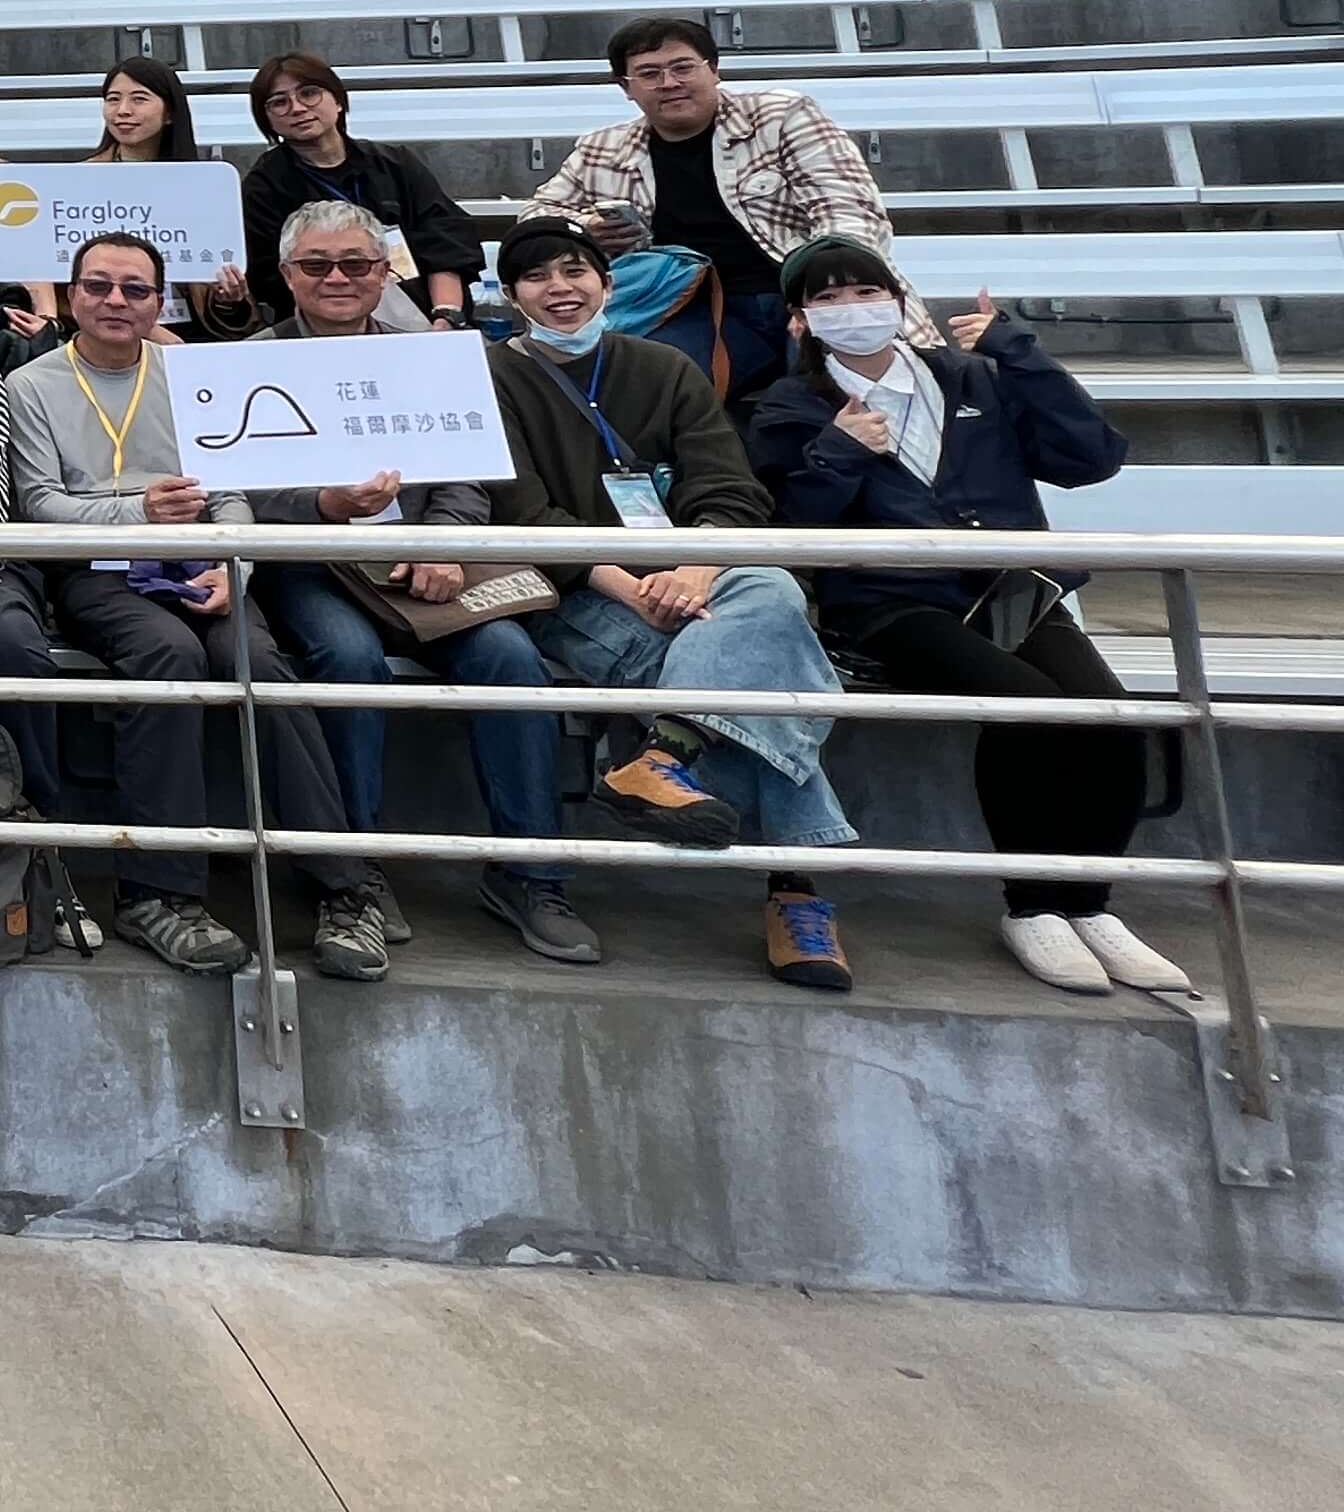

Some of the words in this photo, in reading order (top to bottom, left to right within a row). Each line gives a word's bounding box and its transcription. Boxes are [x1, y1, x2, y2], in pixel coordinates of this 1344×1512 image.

[53, 200, 152, 224] Farglory
[335, 380, 383, 402] 花蓮
[342, 410, 485, 436] 福爾摩沙協會
